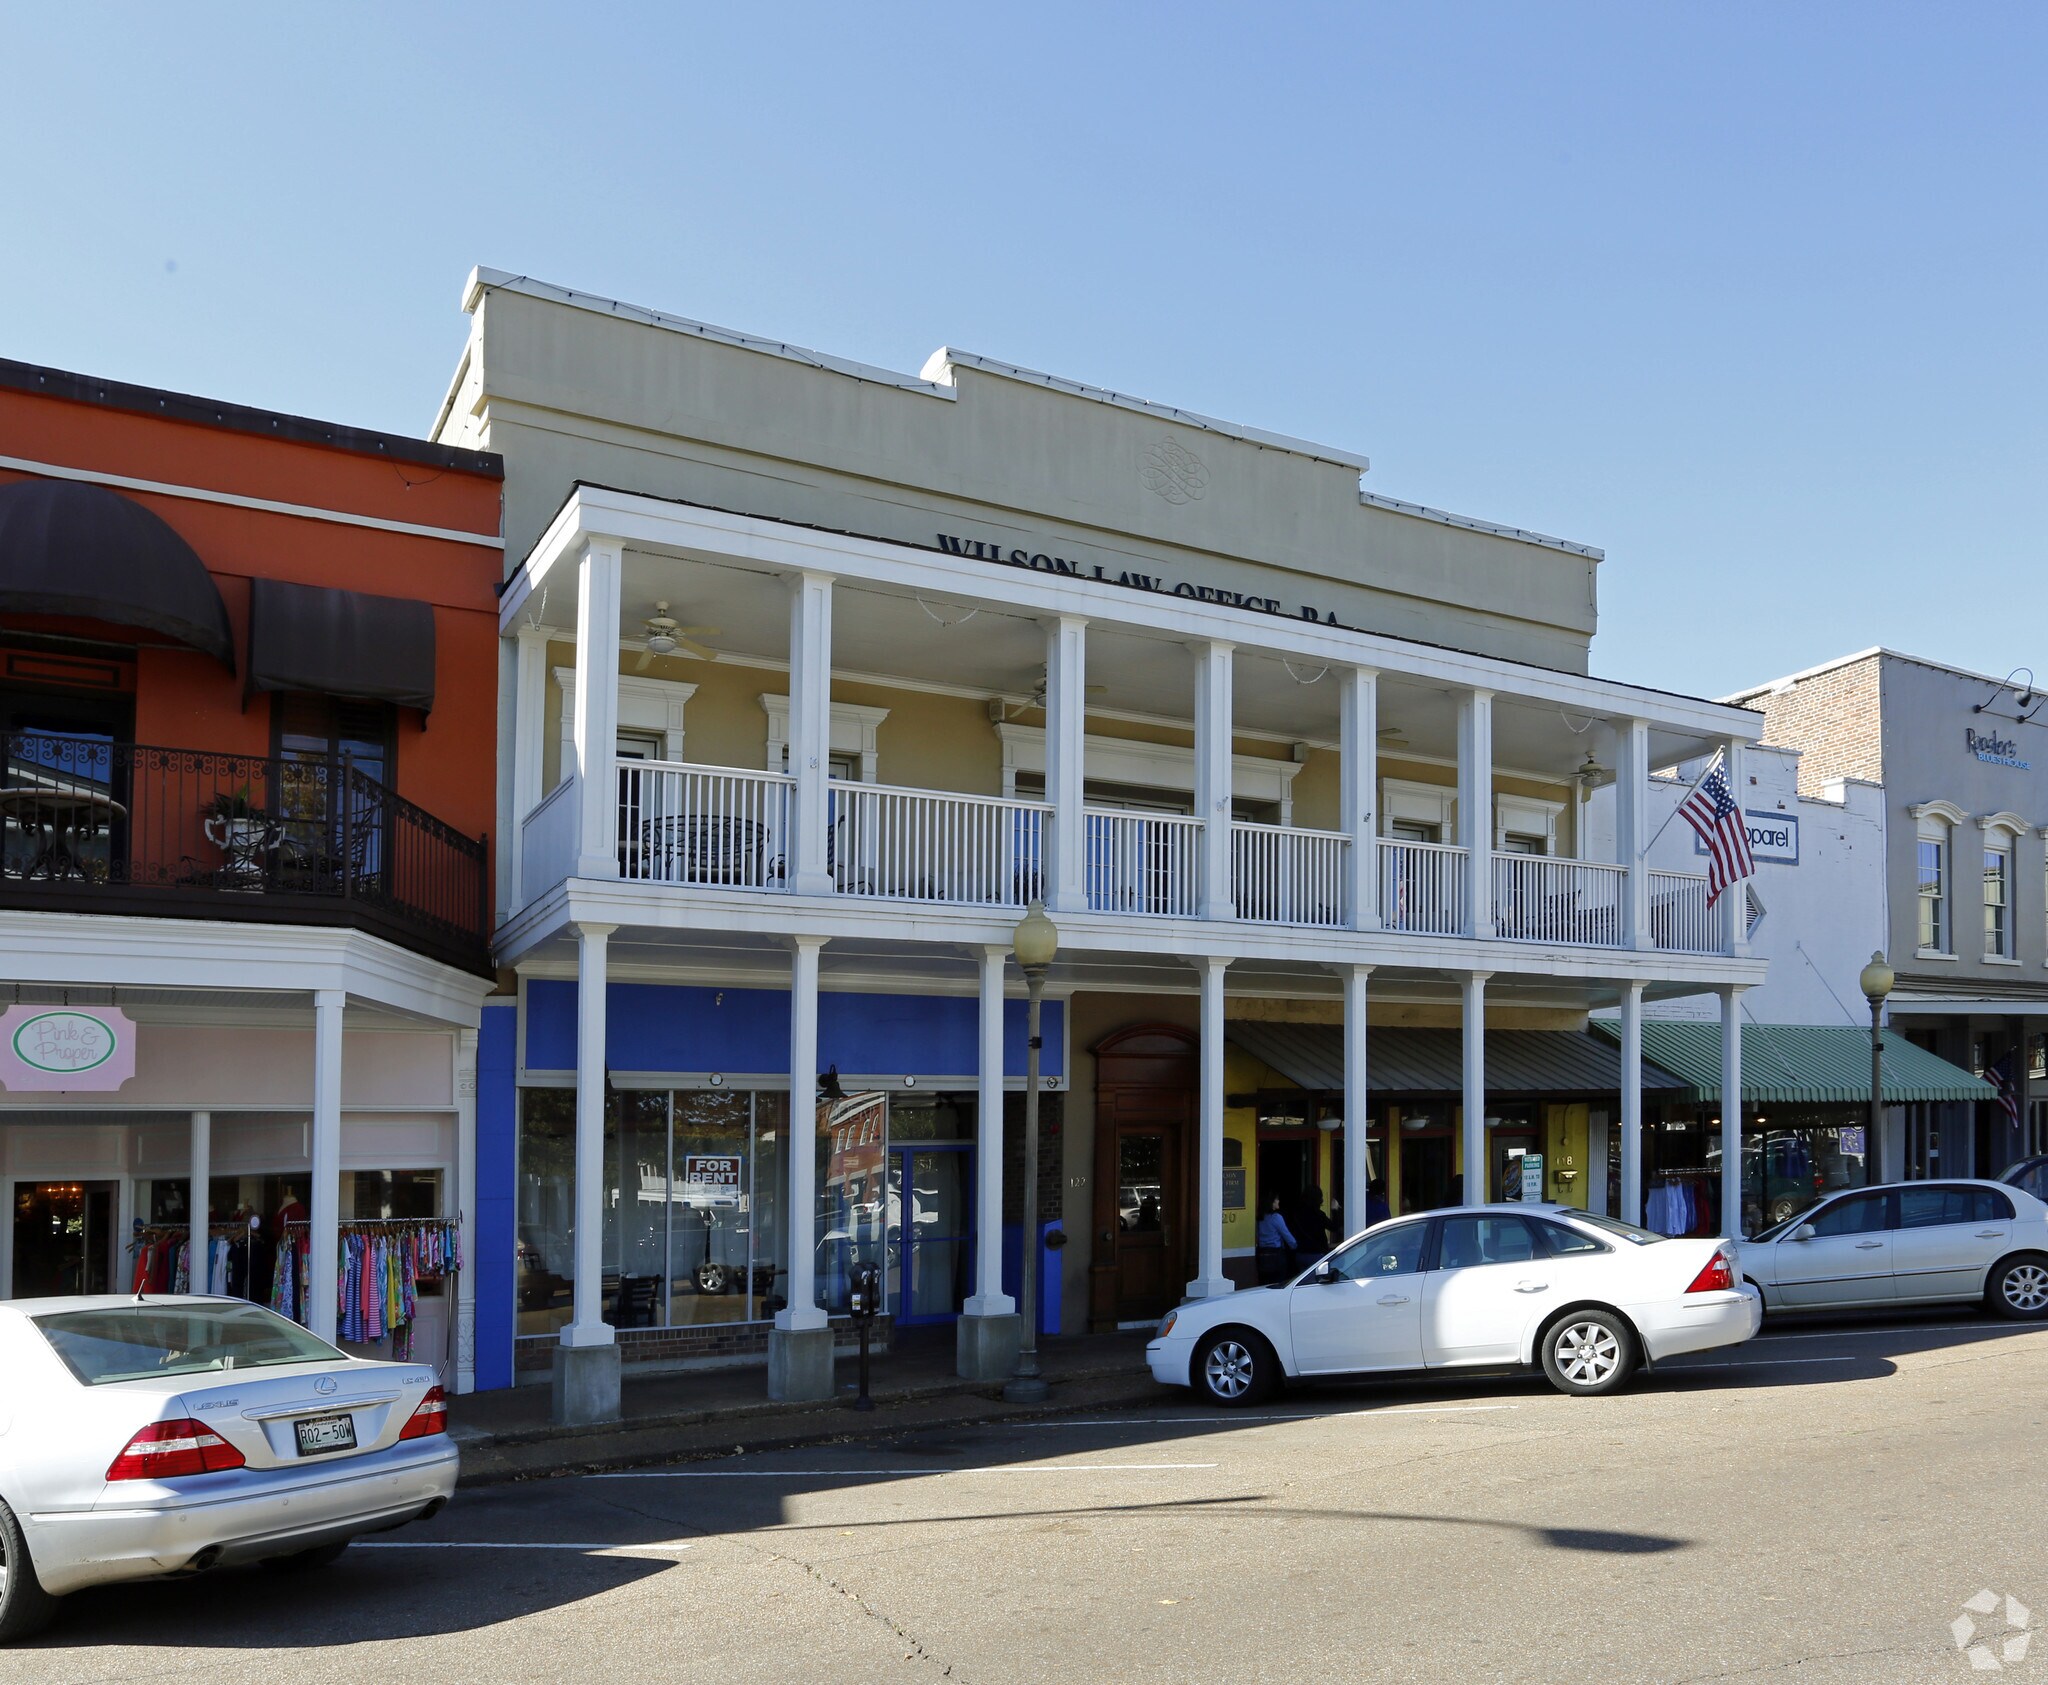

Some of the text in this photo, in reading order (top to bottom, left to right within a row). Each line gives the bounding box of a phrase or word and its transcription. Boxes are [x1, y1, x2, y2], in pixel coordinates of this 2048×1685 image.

[1978, 752, 2032, 771] BLUES HOUSE
[1746, 827, 1788, 848] parel
[31, 1021, 100, 1046] Pink &
[34, 1041, 97, 1067] Proper
[696, 1160, 731, 1171] FOR
[689, 1172, 737, 1184] RENT
[1222, 1212, 1236, 1223] 20
[193, 1398, 239, 1411] LEXUS
